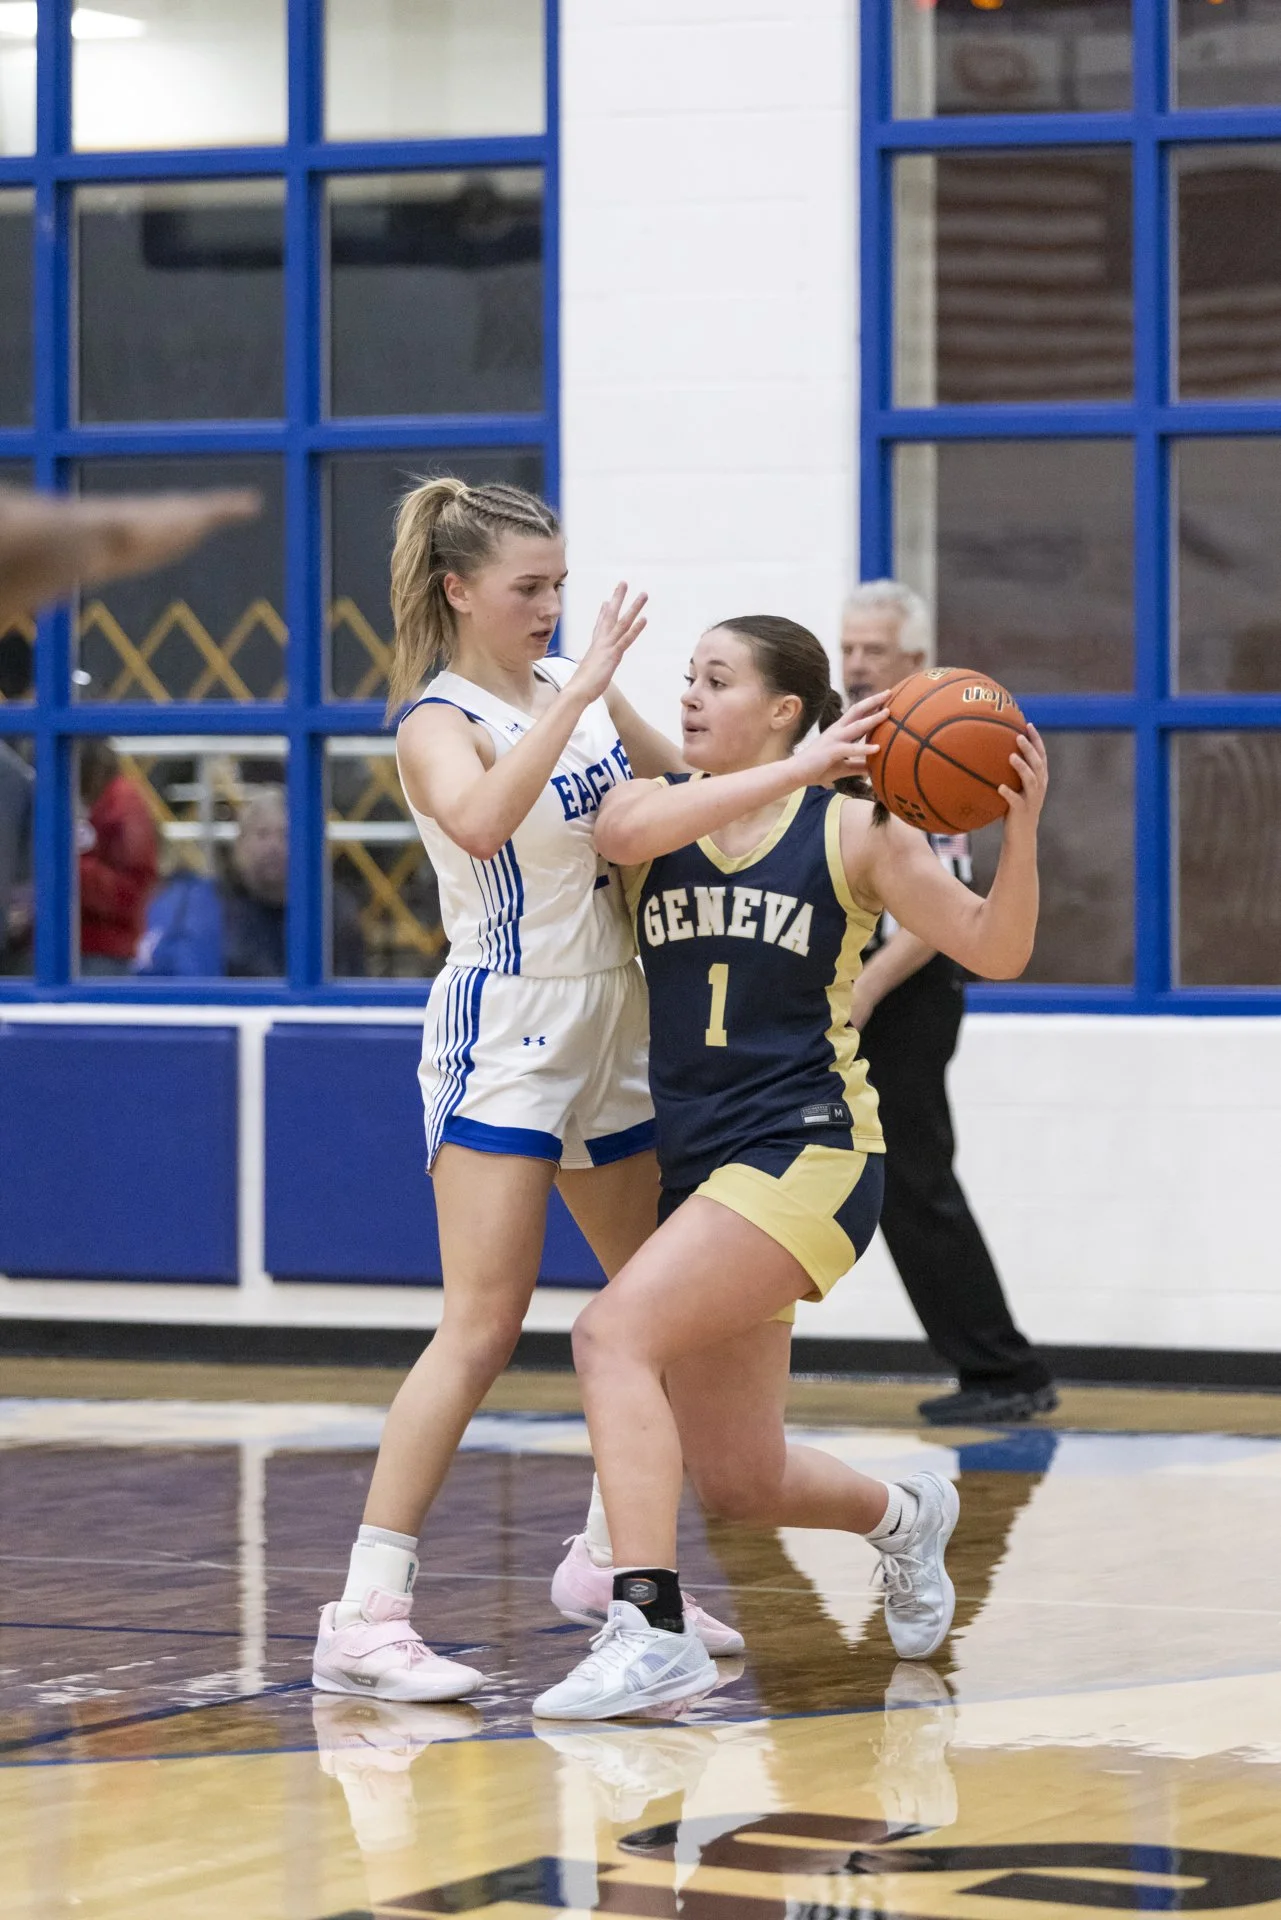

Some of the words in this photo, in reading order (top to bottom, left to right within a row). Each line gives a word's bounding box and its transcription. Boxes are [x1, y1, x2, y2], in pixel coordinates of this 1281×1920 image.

[643, 886, 814, 957] GENEVA
[705, 963, 729, 1047] 1
[834, 1108, 843, 1118] M
